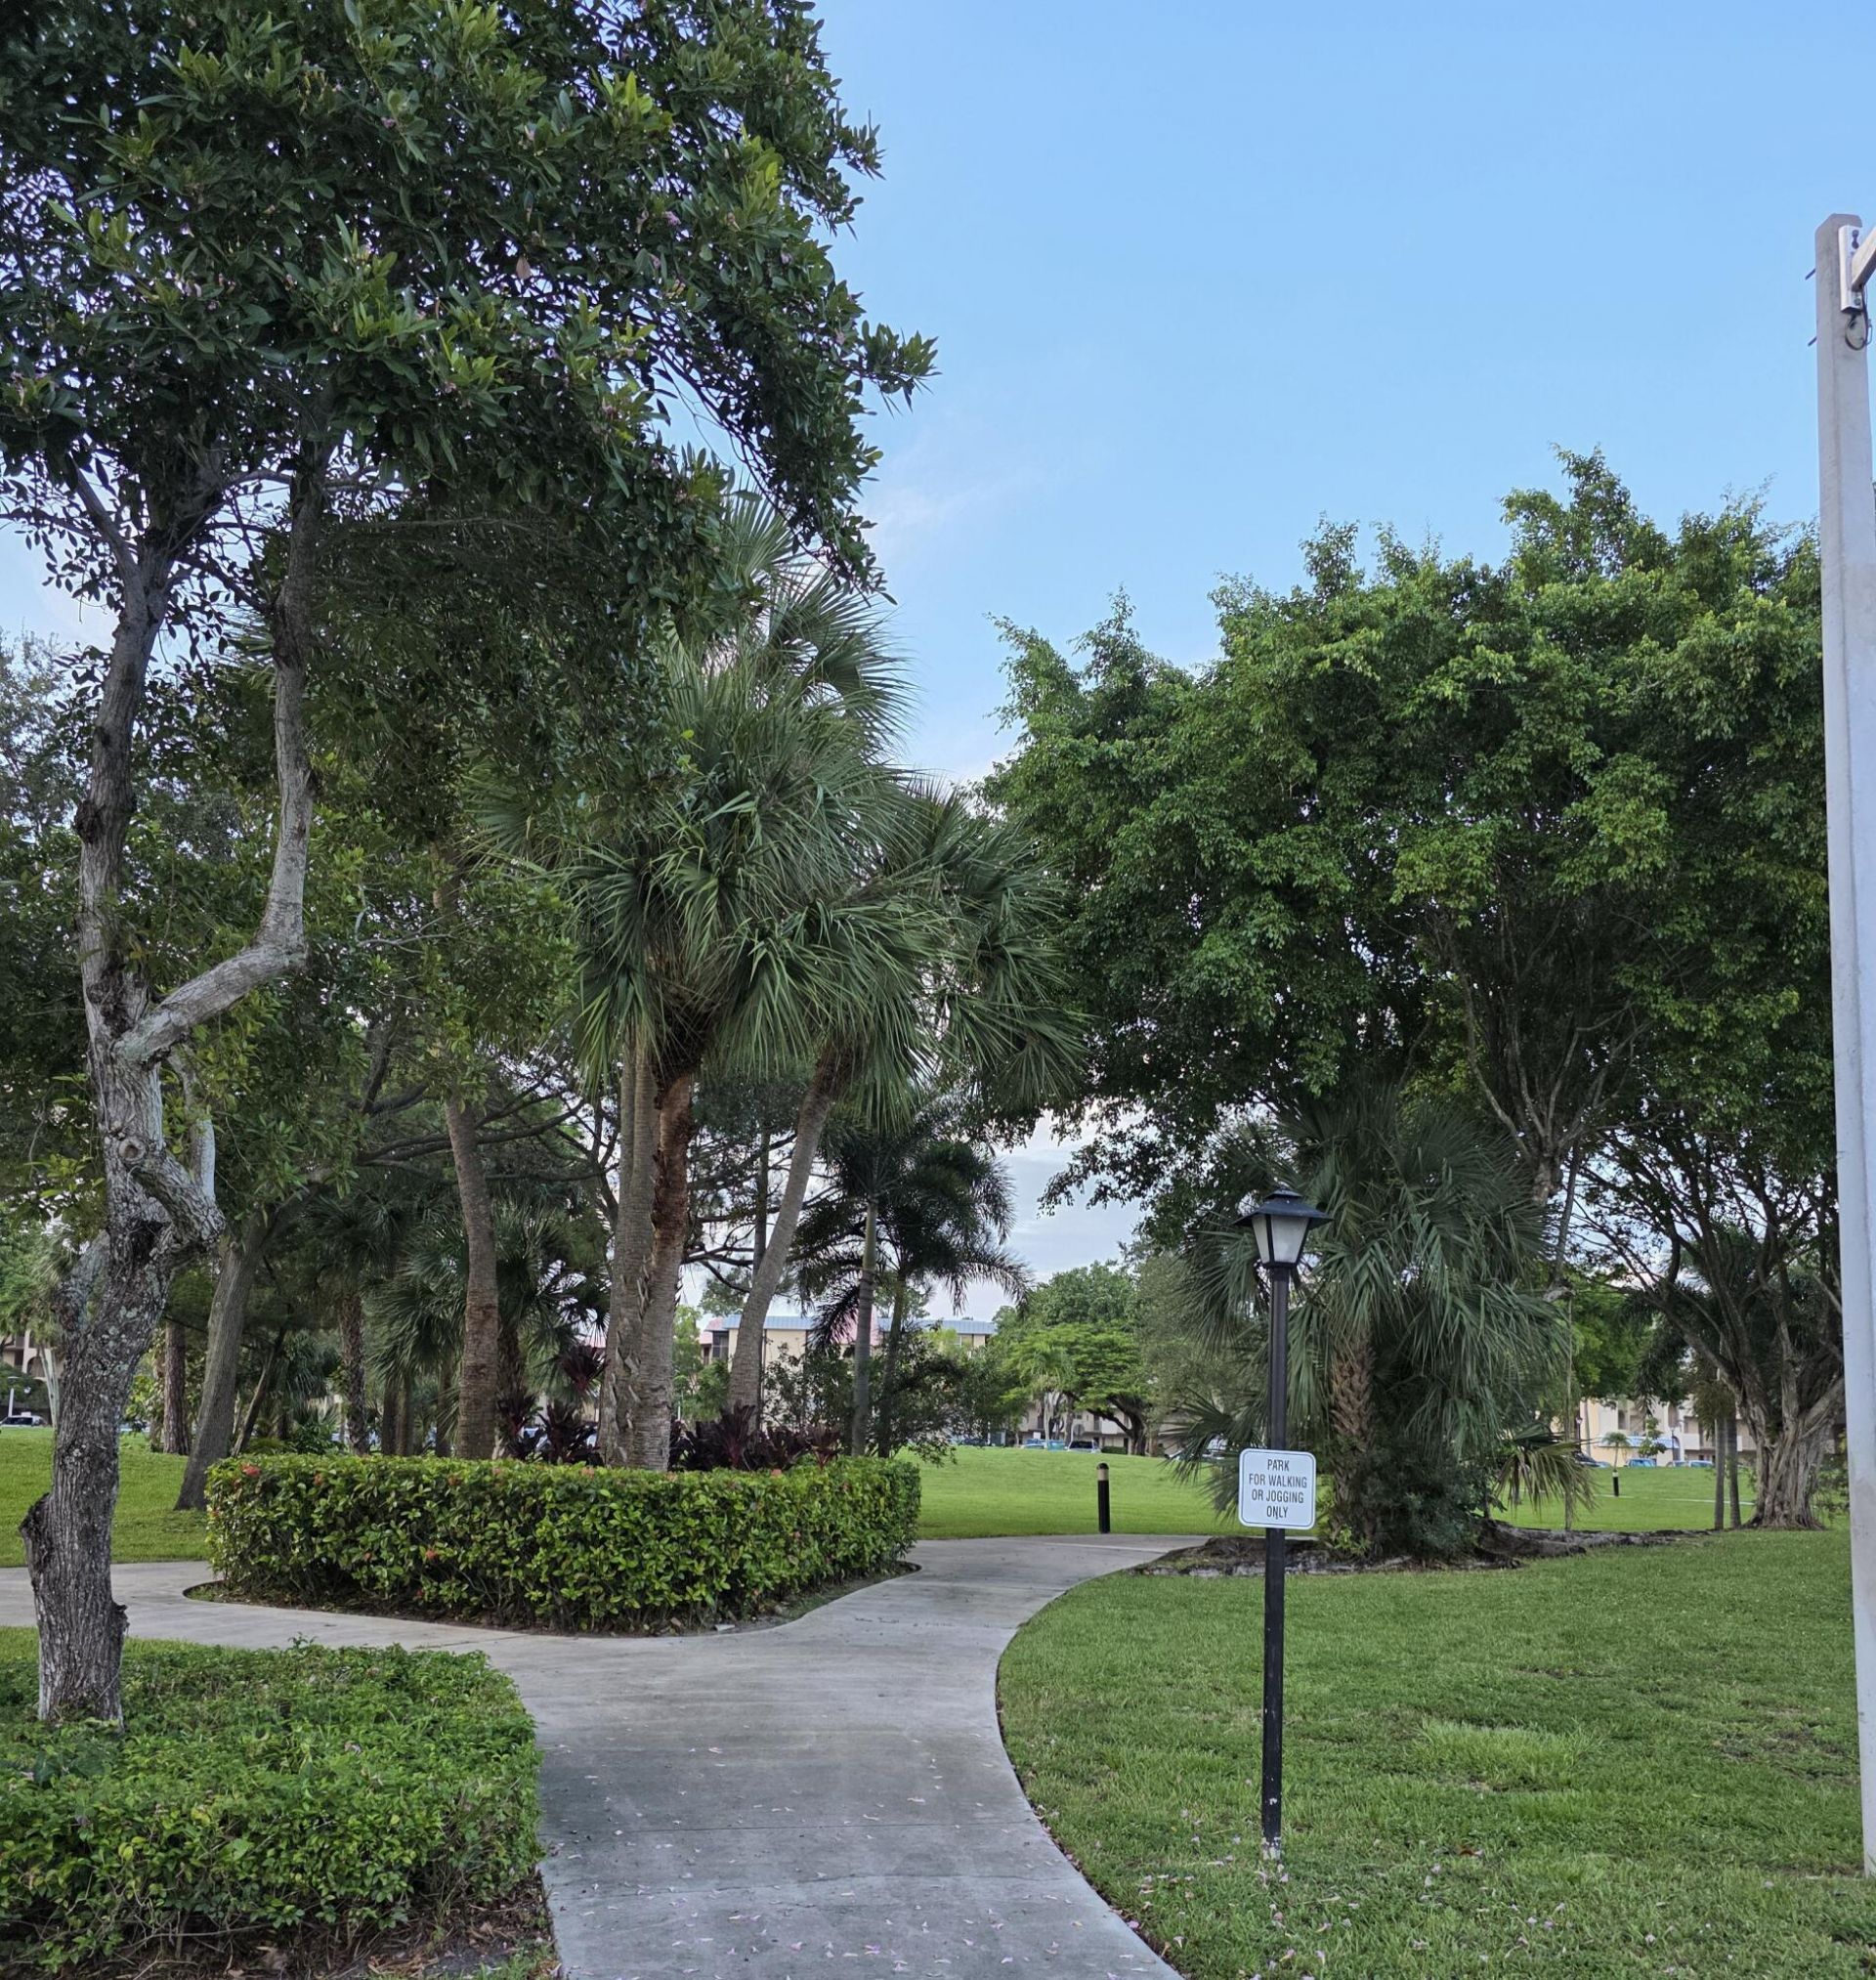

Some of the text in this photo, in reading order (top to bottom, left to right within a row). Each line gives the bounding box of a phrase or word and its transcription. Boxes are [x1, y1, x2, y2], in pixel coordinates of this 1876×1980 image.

[1267, 1459, 1290, 1472] PARK
[1249, 1473, 1307, 1488] FOR WALKING
[1252, 1488, 1304, 1503] OR JOGGING
[1266, 1505, 1289, 1520] ONLY
